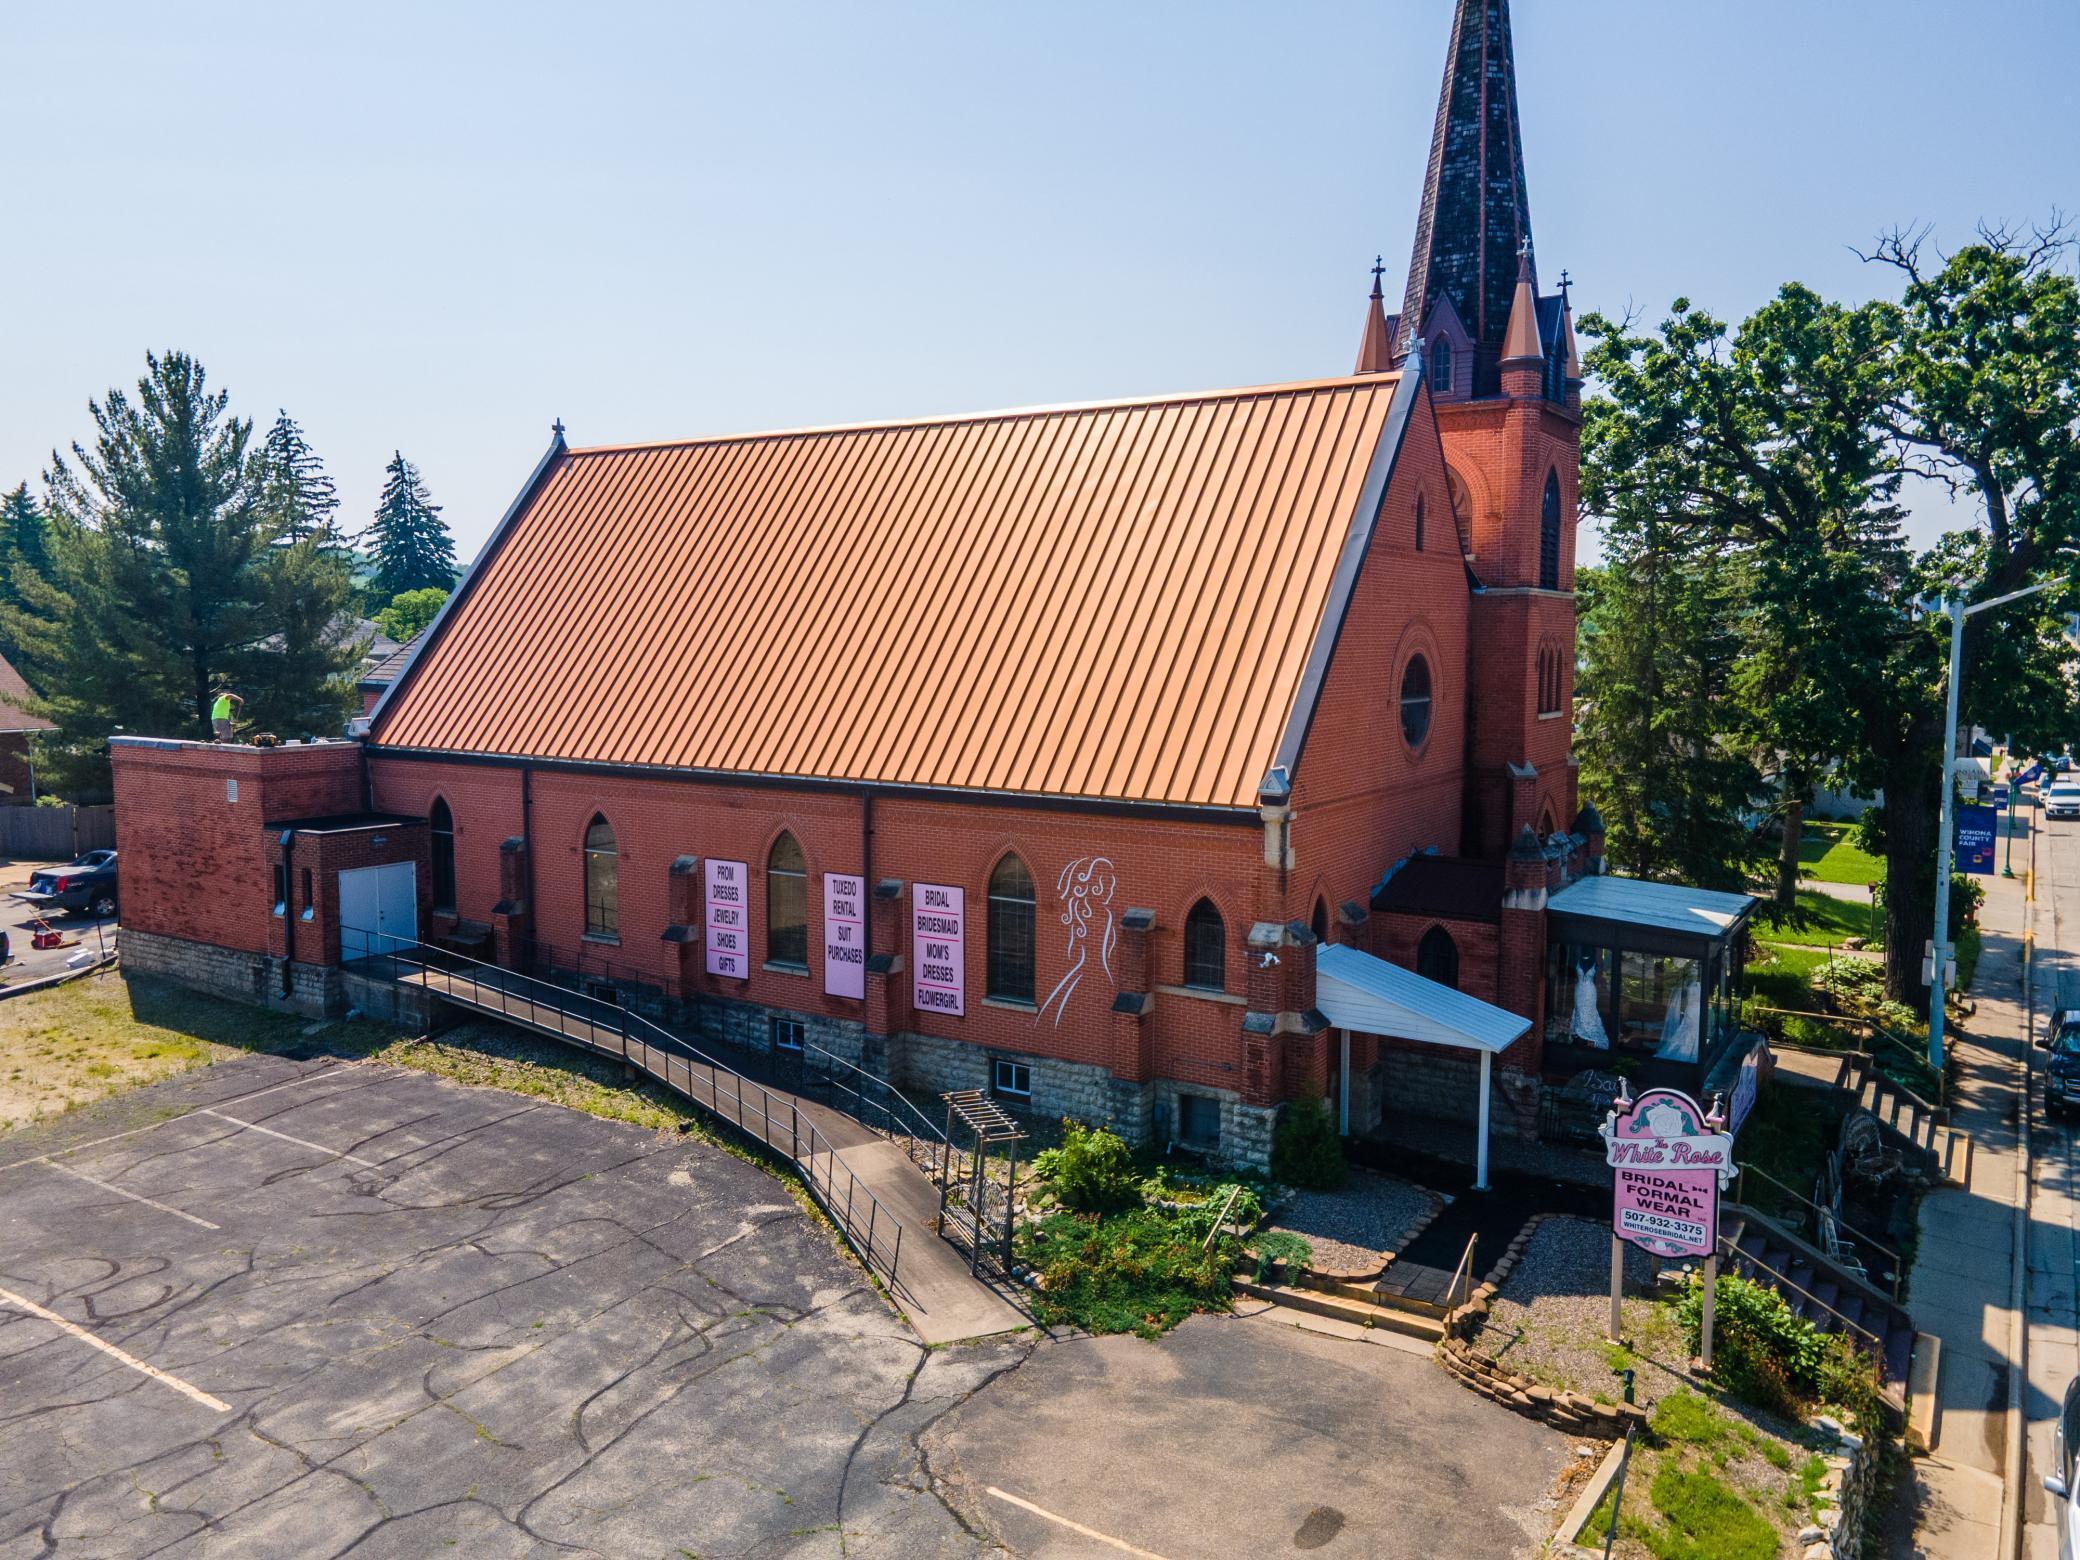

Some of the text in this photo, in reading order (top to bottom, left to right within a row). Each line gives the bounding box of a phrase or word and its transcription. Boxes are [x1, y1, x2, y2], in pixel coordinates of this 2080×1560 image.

[1959, 834, 1991, 843] COUNTY
[717, 865, 734, 881] PROM
[713, 884, 739, 902] DRESSES
[833, 879, 857, 897] TUXEDO
[925, 890, 950, 908] BRIDAL
[713, 908, 739, 926] JEWELRY
[833, 900, 856, 917] RENTAL
[838, 926, 852, 943] SUIT
[917, 916, 959, 936] BRIDESMAID
[717, 932, 736, 950] SHOES
[828, 945, 863, 965] PURCHASES
[926, 943, 950, 962] MOM'S
[719, 956, 736, 973] GIFTS
[922, 963, 954, 984] DRESSES
[918, 989, 959, 1010] FLOWERGIRL
[1654, 1137, 1669, 1150] The
[1611, 1141, 1724, 1165] White Rose
[1621, 1171, 1689, 1194] BRIDAL
[1626, 1184, 1704, 1209] FORMAL
[1636, 1197, 1690, 1219] WEAR
[1624, 1210, 1703, 1236] 507-932-3375
[1623, 1221, 1703, 1245] WHITEROSEBRIDAL.NET
